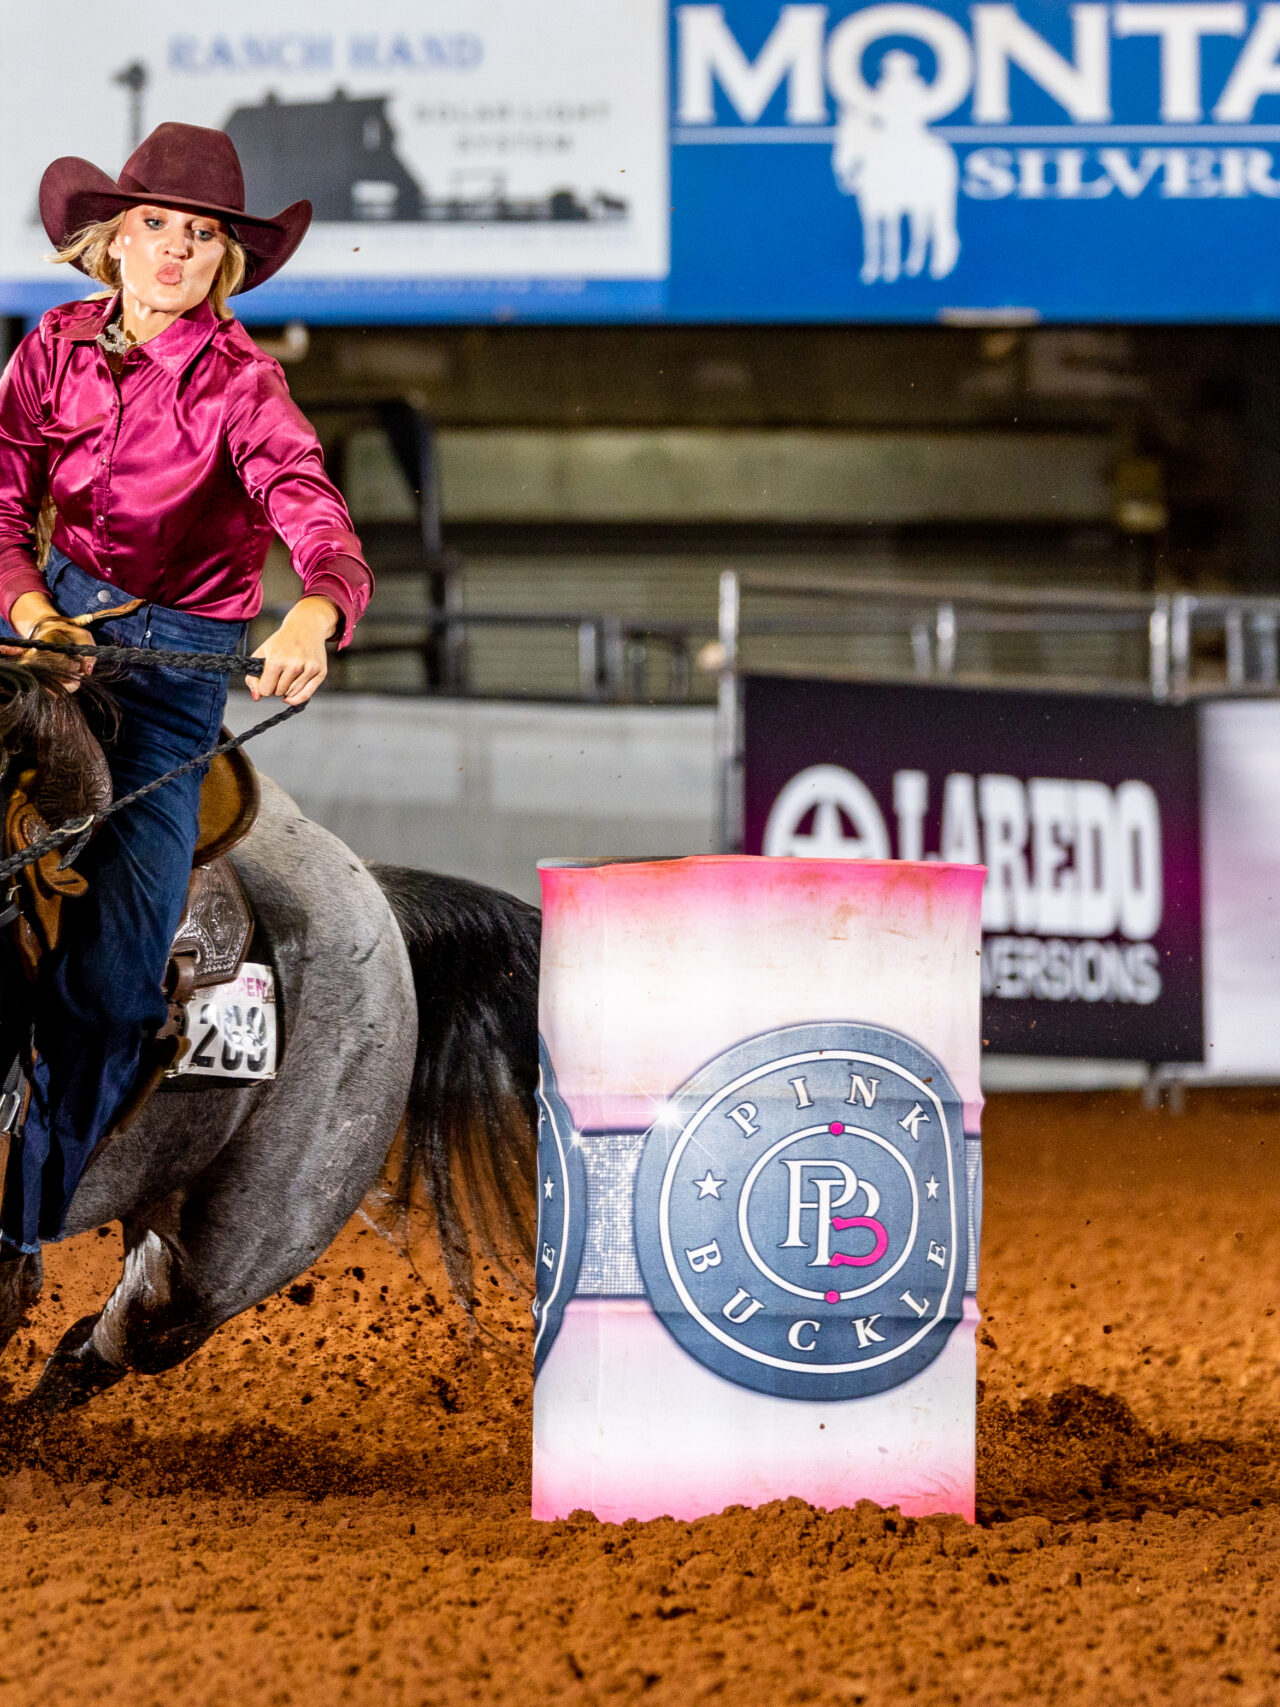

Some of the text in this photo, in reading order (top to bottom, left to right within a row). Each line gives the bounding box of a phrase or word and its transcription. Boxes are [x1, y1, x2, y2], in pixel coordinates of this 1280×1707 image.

[167, 32, 485, 73] RANCH HAND
[963, 147, 1280, 200] SILVER
[891, 768, 1163, 942] LAREDO
[726, 1074, 931, 1142] PINK
[684, 1239, 947, 1353] BUCKLE
